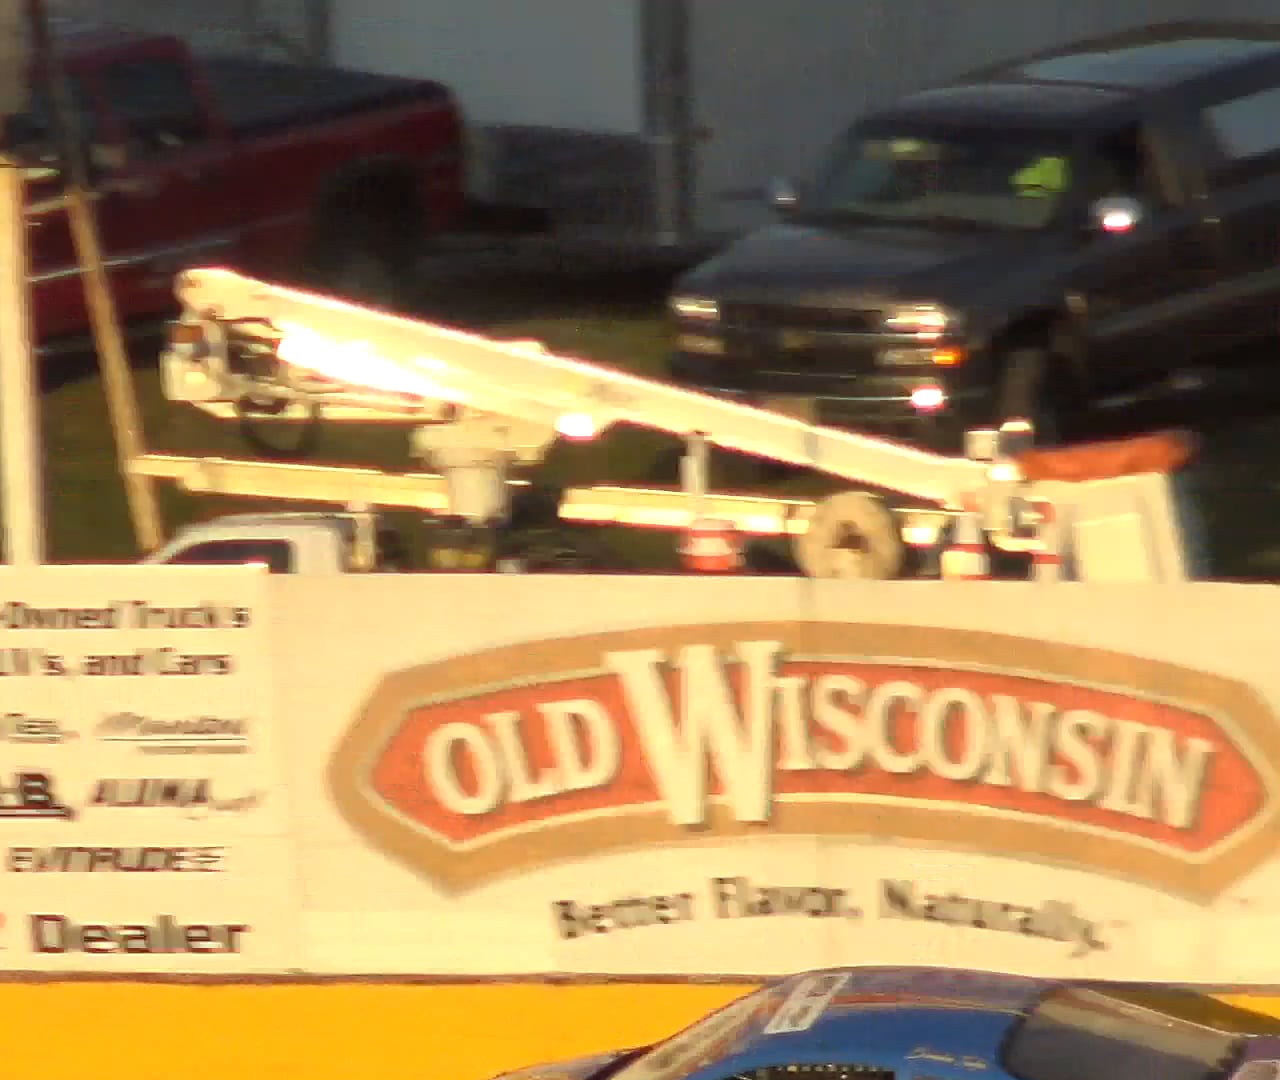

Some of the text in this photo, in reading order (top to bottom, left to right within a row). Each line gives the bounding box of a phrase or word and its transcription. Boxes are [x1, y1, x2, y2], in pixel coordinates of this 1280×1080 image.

[422, 640, 1217, 828] OLD WISCONSIN
[30, 913, 252, 955] Dealer
